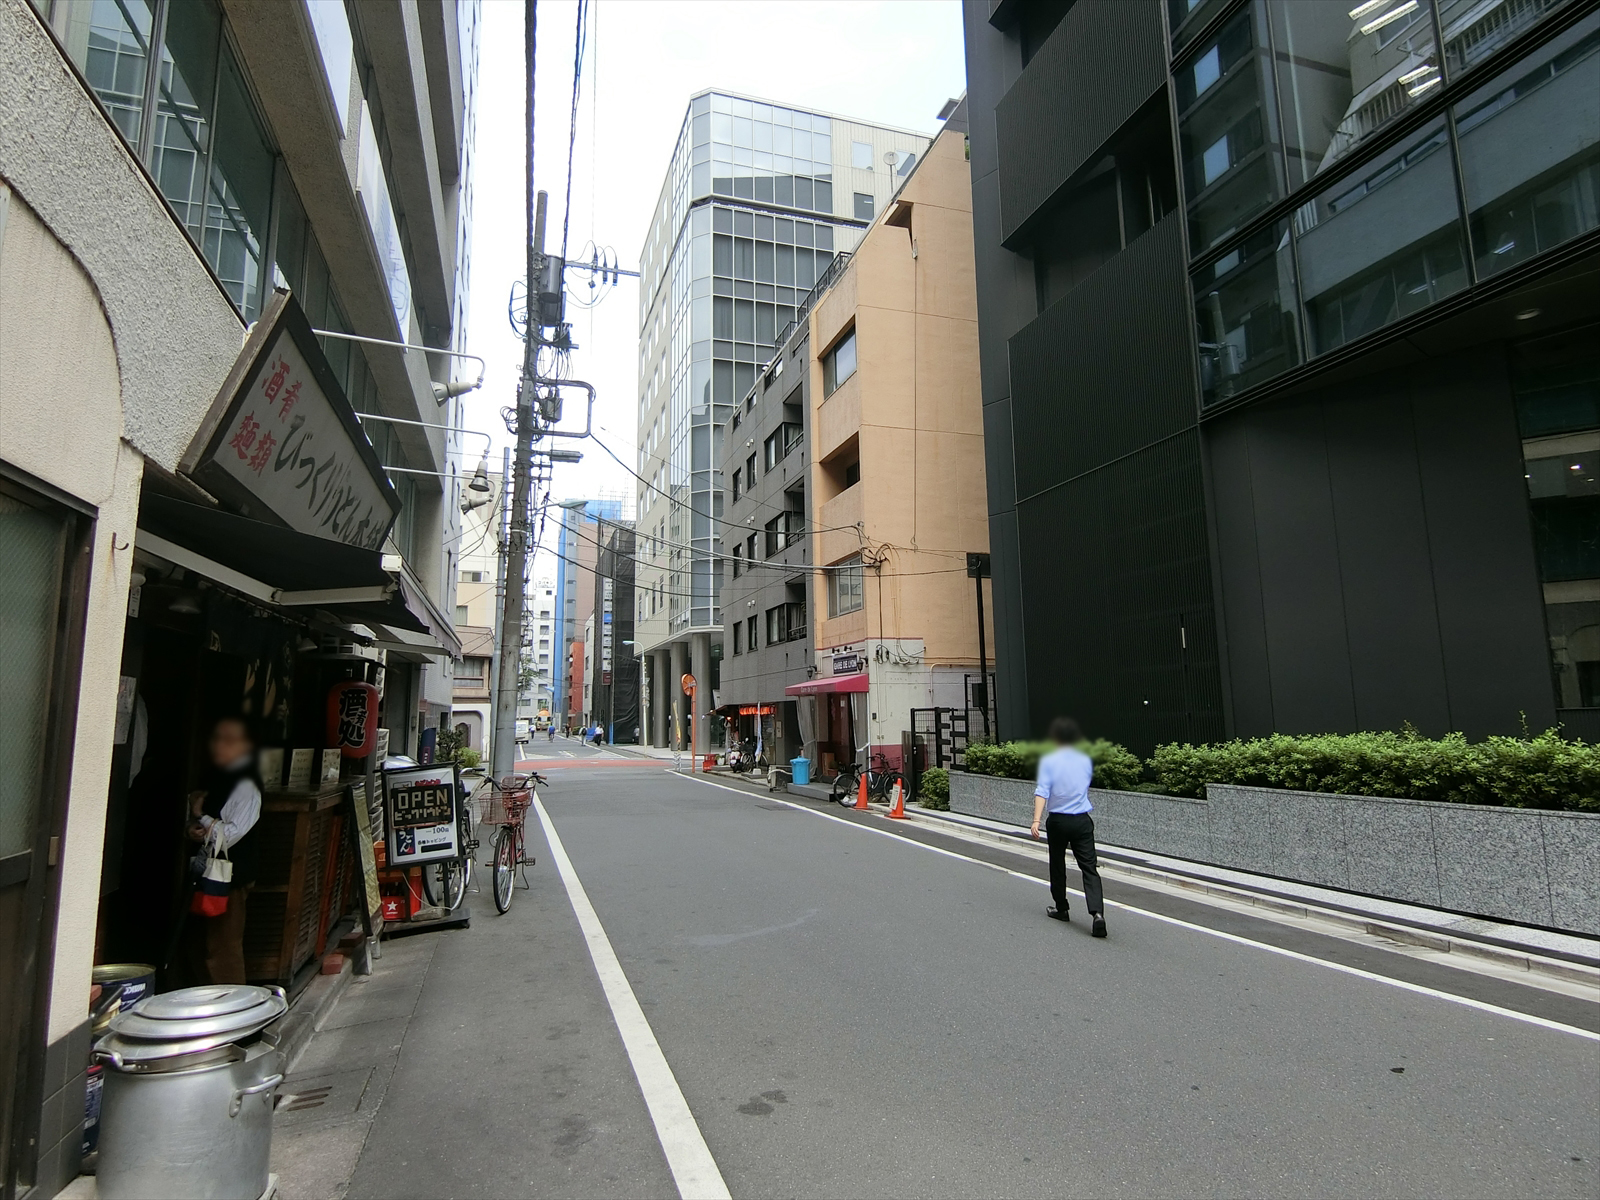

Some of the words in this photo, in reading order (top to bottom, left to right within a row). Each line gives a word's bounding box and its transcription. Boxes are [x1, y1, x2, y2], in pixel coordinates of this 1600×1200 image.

[261, 353, 303, 424] 酒肴
[337, 688, 368, 748] 酒肴処
[397, 788, 448, 809] OPEN
